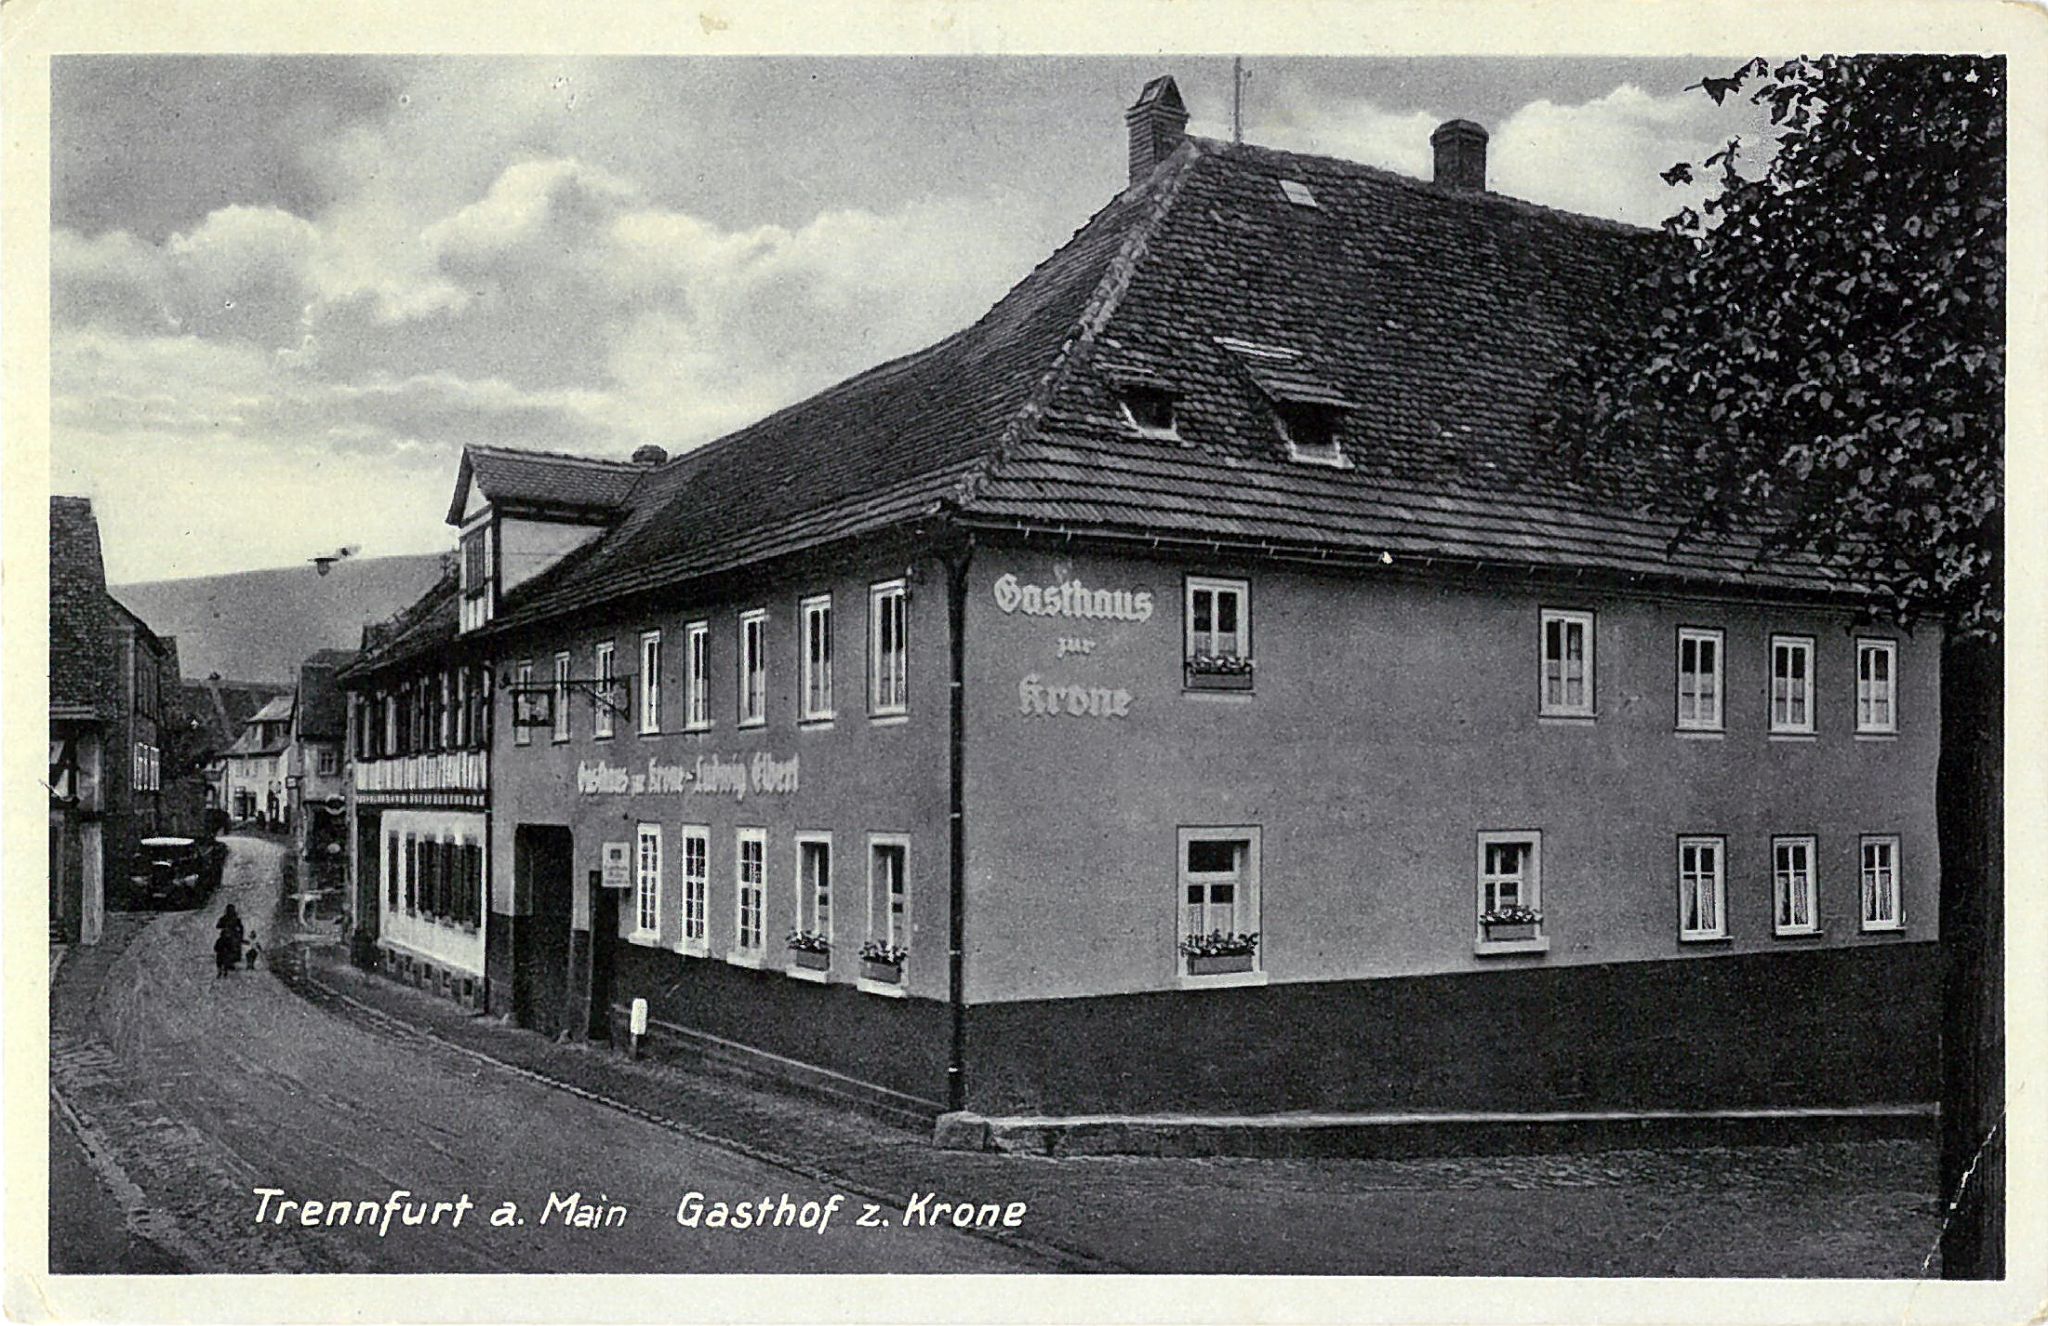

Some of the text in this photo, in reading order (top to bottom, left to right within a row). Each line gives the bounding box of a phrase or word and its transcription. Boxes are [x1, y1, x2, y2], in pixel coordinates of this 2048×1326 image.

[994, 573, 1153, 623] Gasthaus
[1057, 637, 1096, 659] zur
[1019, 673, 1133, 717] Krone
